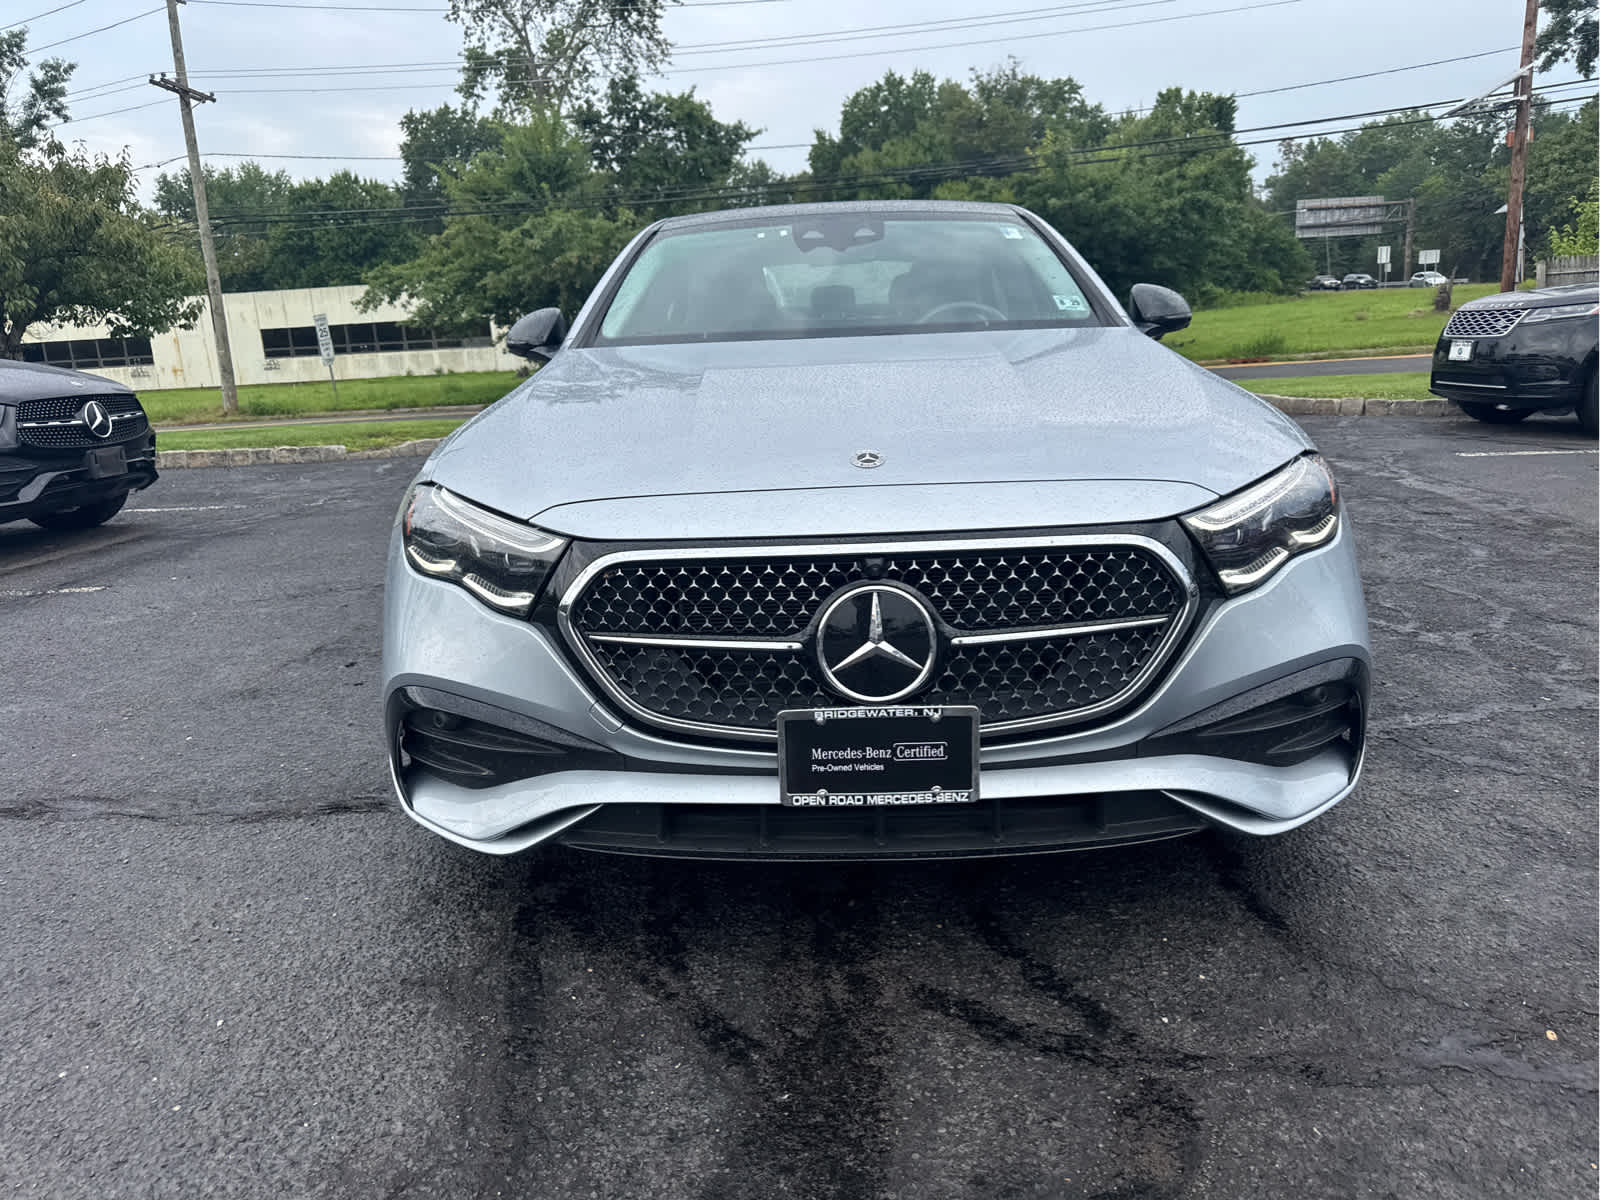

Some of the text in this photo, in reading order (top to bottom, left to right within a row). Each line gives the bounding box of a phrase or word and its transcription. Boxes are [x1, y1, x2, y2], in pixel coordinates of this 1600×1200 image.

[319, 327, 329, 338] 25
[814, 708, 942, 720] BRIDGEWATER, NJ
[811, 745, 945, 760] Mercedes-Benz Certified
[811, 763, 884, 772] Pre-Owned Vehicles
[792, 792, 969, 806] OPEN ROAD MERCEDES-BENZ
